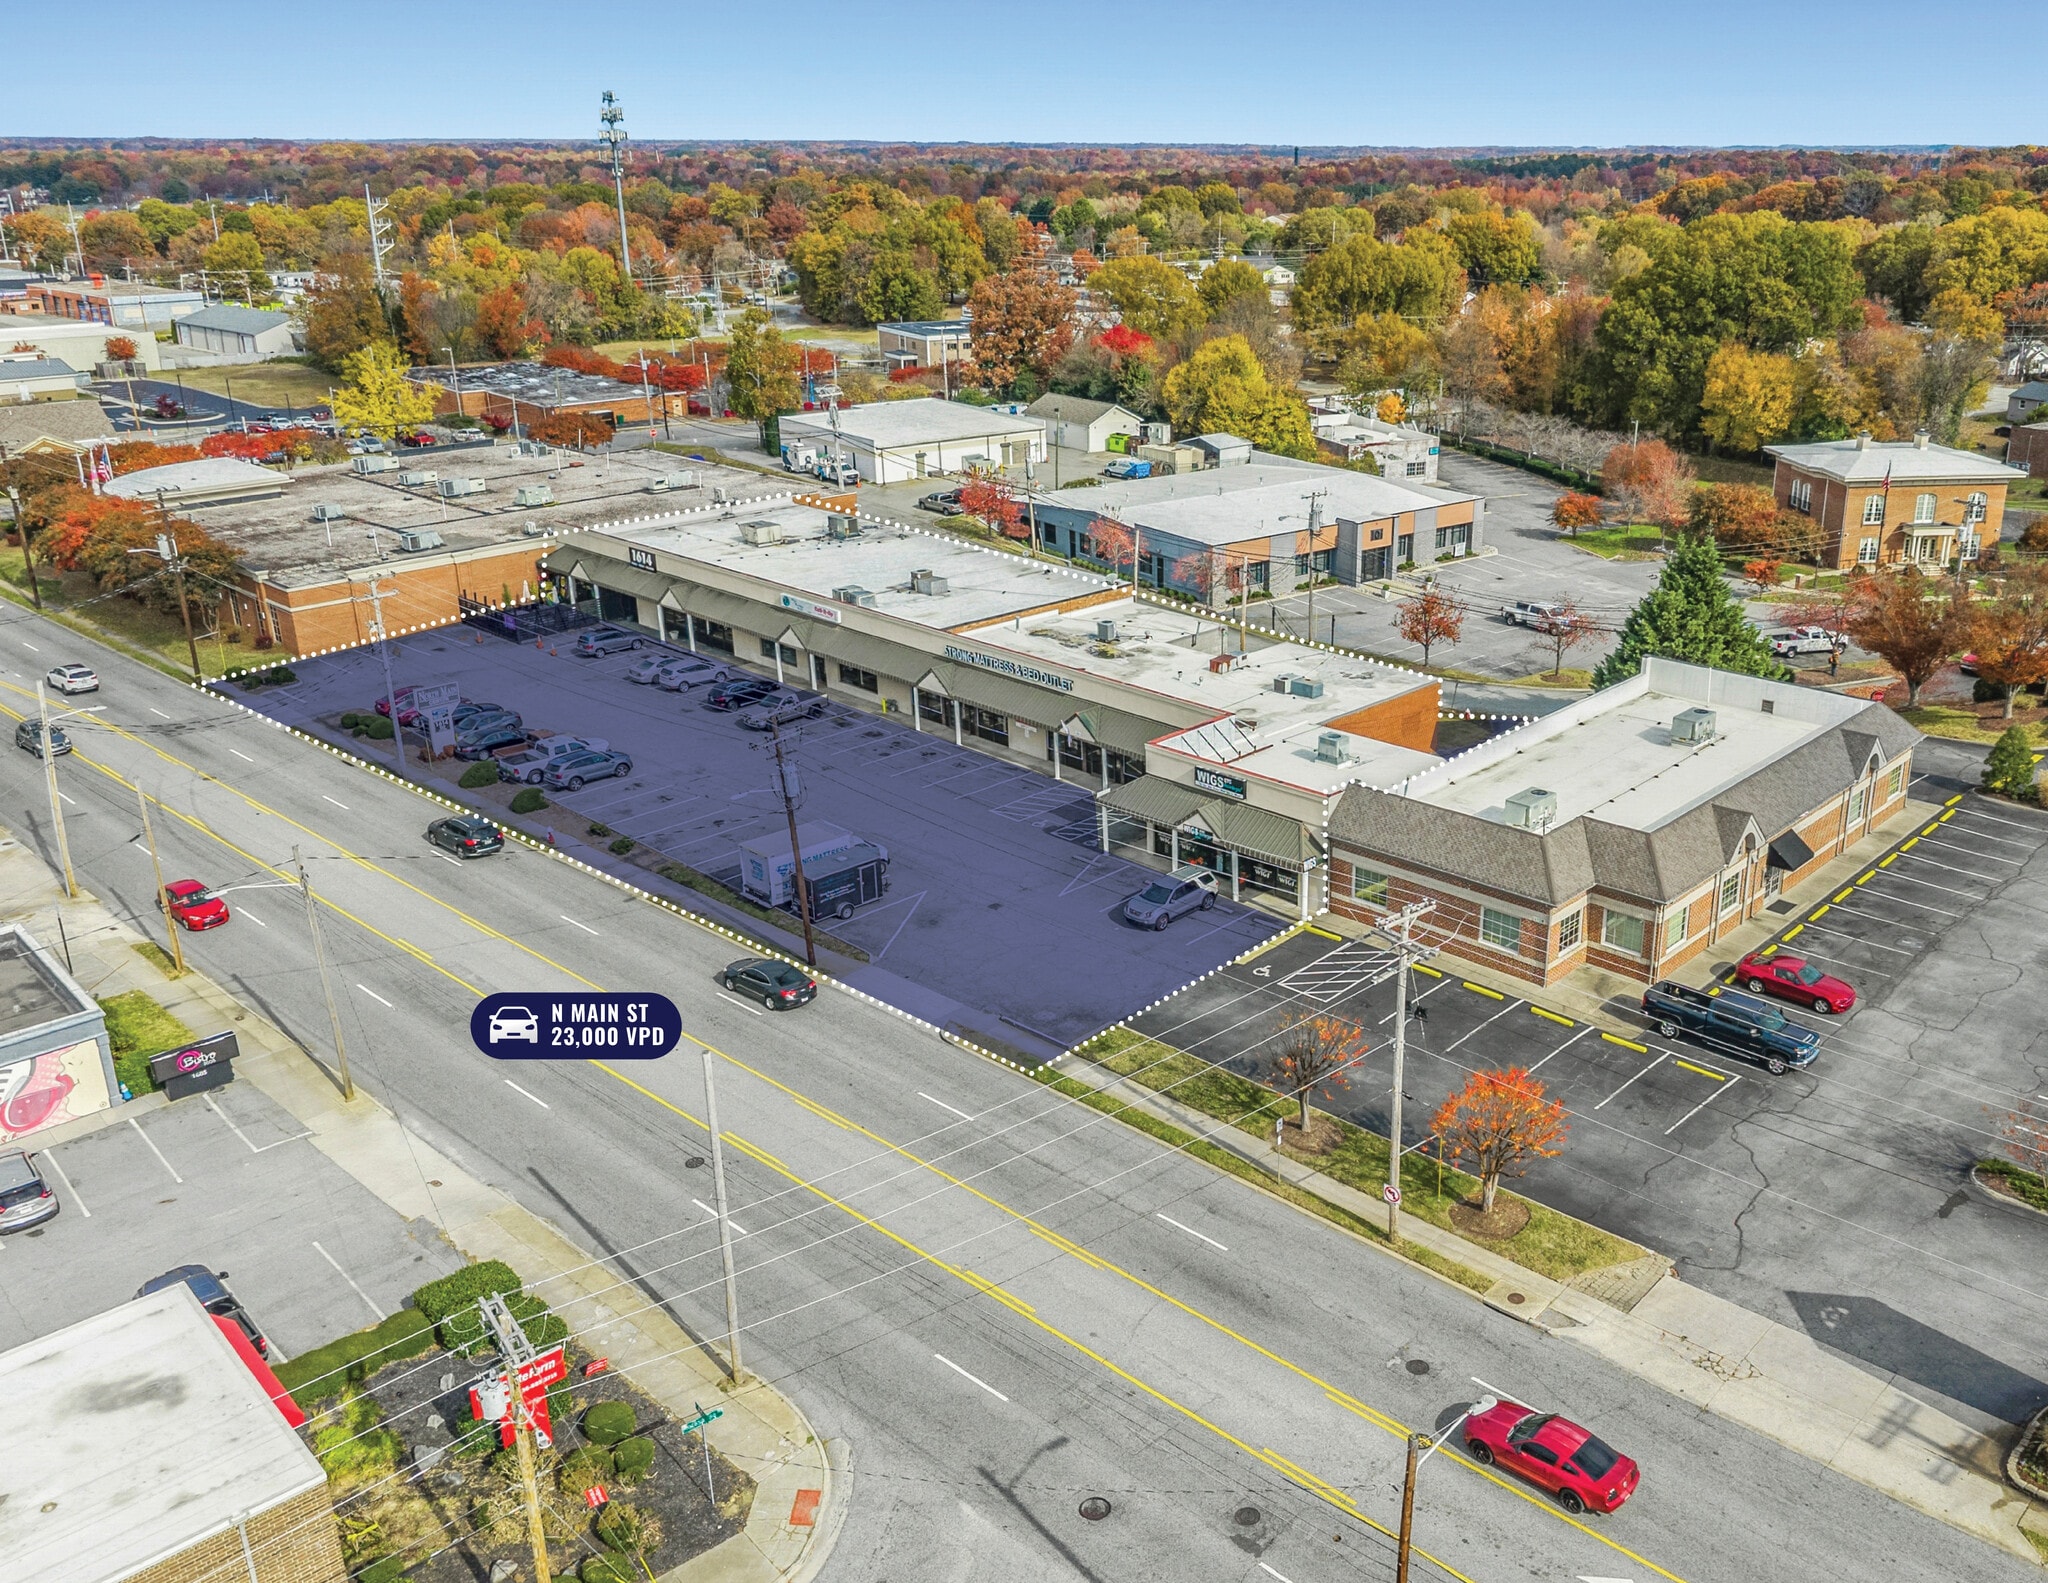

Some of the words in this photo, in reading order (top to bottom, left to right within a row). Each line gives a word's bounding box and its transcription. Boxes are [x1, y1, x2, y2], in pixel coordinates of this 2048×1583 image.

[631, 549, 653, 566] 1614
[945, 645, 975, 664] STRONG
[974, 653, 1014, 674] MATTRESS
[1015, 665, 1024, 676] &
[1023, 667, 1040, 682] BED
[1040, 672, 1074, 691] OUTLET
[1196, 770, 1224, 788] WIGS
